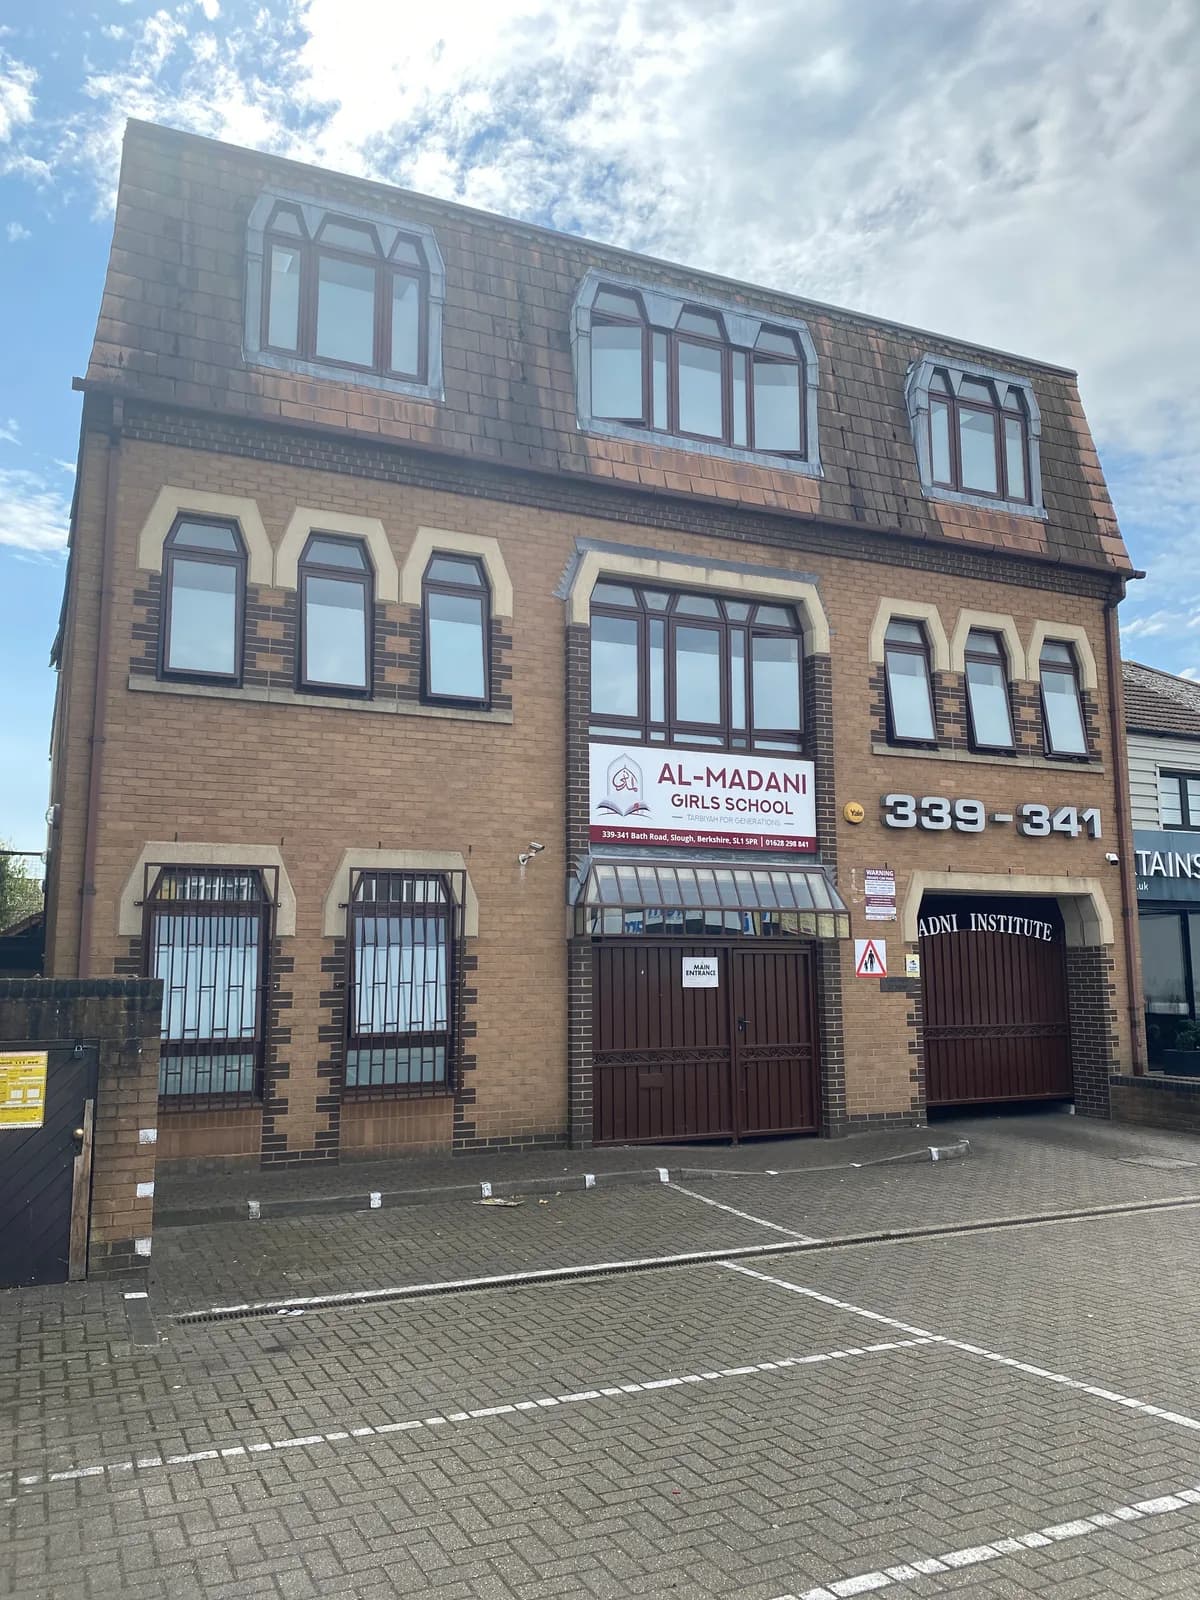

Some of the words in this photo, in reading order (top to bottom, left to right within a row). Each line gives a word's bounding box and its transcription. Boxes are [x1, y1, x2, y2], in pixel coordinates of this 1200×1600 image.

[658, 763, 806, 794] AL-MADANI
[671, 794, 720, 810] GIRLS
[725, 797, 793, 815] SCHOOL
[850, 808, 863, 817] Yale
[687, 814, 718, 822] TARBIYAH
[720, 816, 734, 824] FOR
[735, 817, 781, 826] GENERATIONS
[602, 830, 629, 839] 339-341
[631, 832, 648, 840] Bath
[649, 833, 669, 842] Road,
[670, 834, 696, 843] Slough,
[697, 835, 731, 845] Berkshire,
[733, 836, 744, 845] SL1
[866, 869, 894, 877] WARNING
[1134, 850, 1200, 879] TAINS
[918, 914, 958, 937] ADNI
[970, 913, 1053, 942] INSTITUTE
